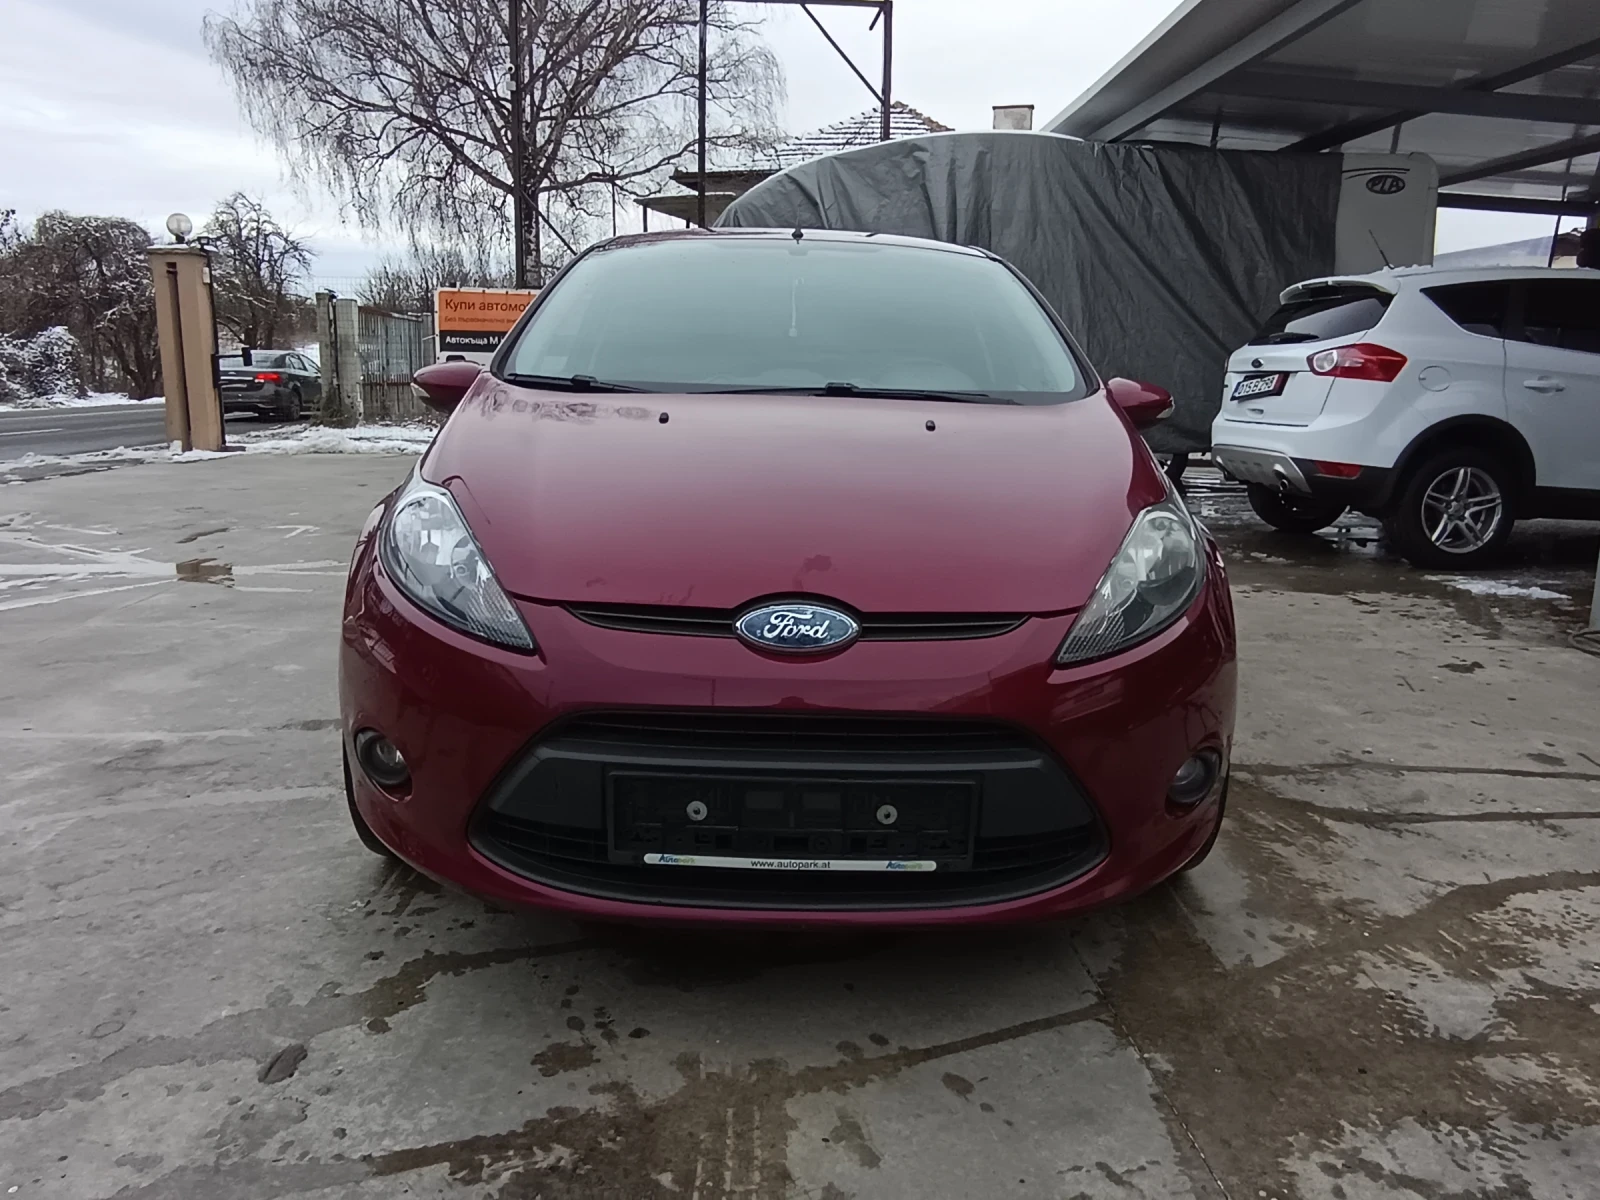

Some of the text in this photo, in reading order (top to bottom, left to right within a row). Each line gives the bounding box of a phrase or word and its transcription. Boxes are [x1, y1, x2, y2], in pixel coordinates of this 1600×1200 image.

[445, 298, 531, 312] Купи автомо
[445, 335, 488, 345] Автокъща
[489, 336, 499, 345] М
[763, 611, 830, 639] Ford
[750, 860, 831, 870] www.autopark.at
